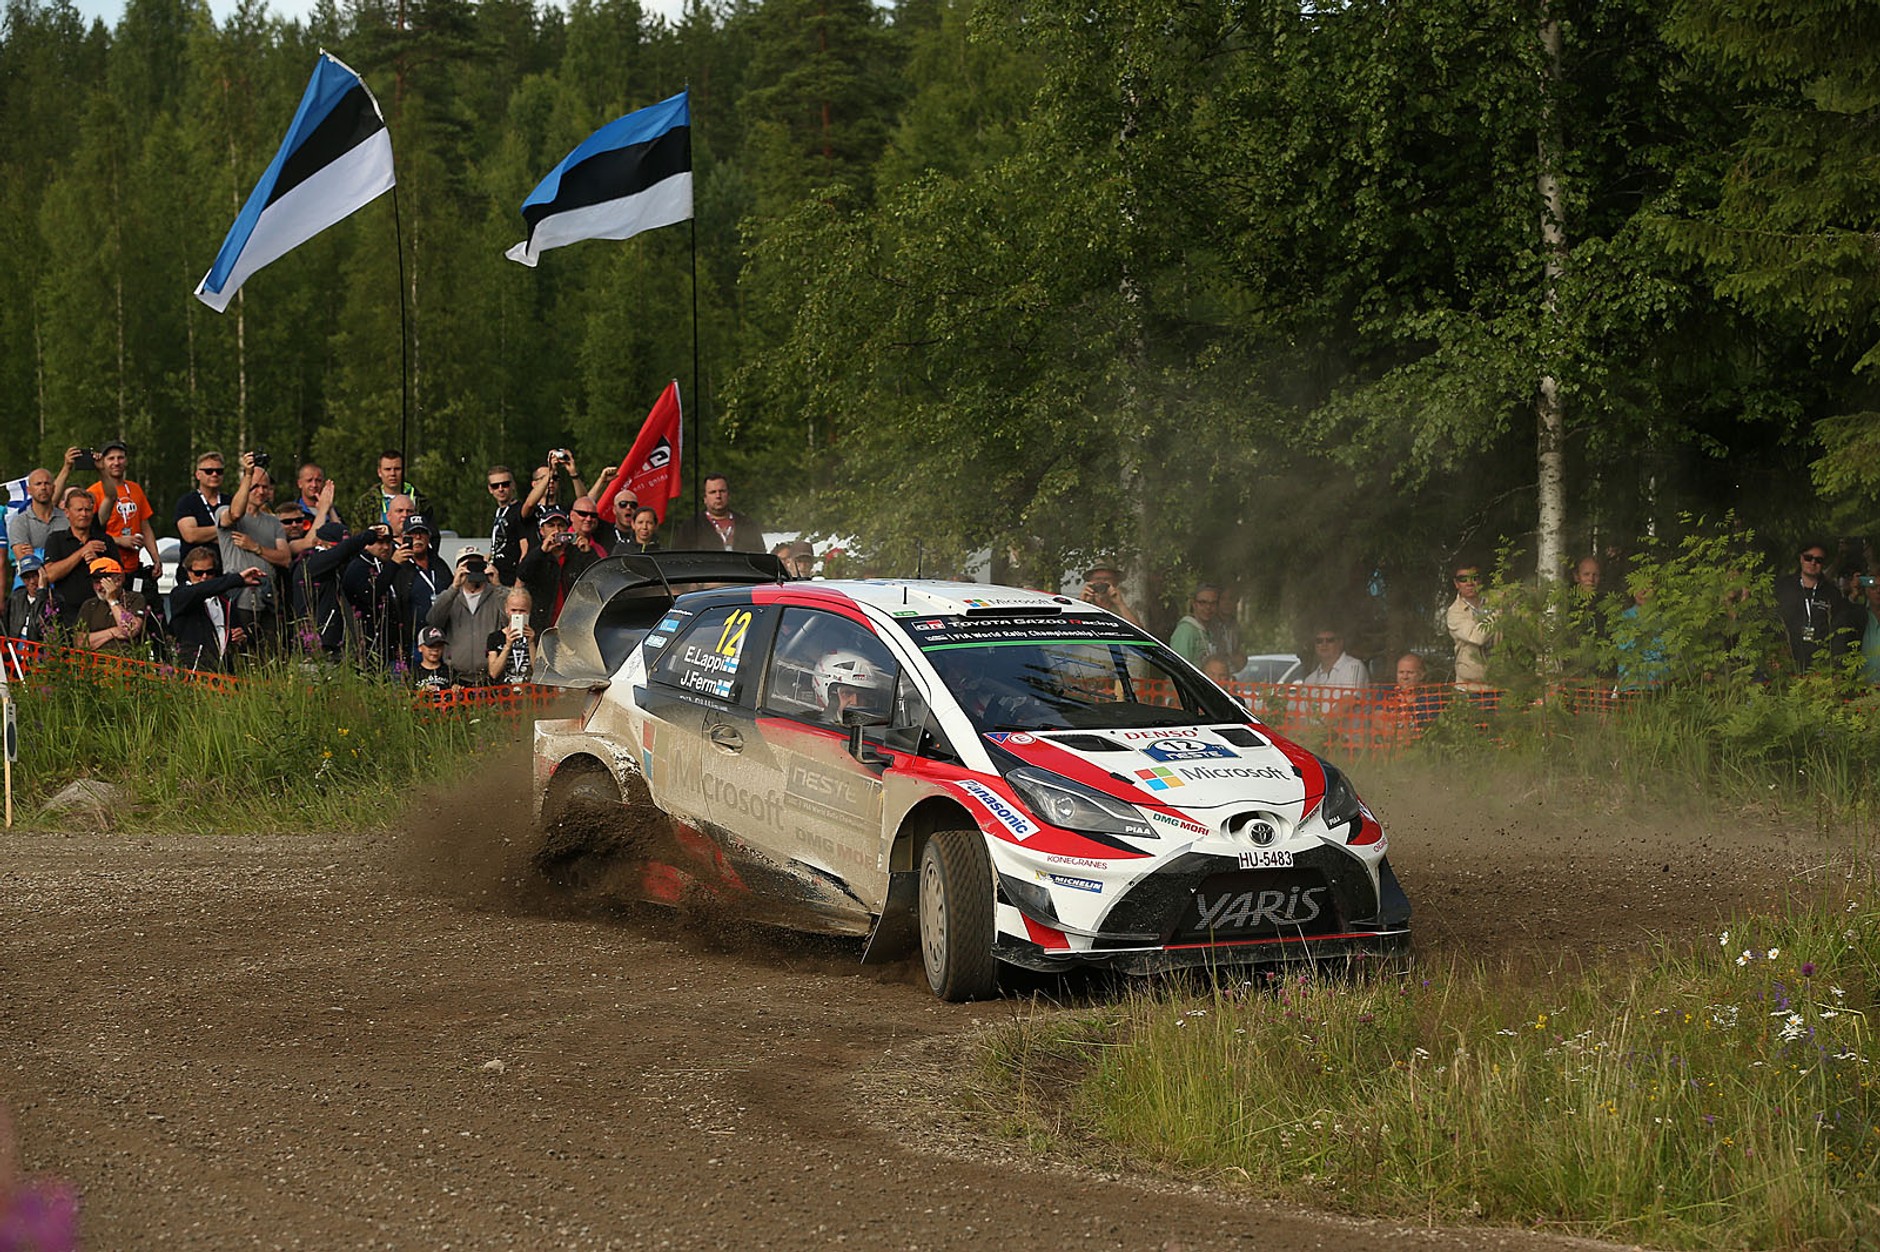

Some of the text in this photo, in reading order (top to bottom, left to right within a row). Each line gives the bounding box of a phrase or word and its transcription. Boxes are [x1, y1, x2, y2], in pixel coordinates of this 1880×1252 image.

[948, 618, 1119, 628] TOYOTA GAZOO Racing
[715, 608, 752, 657] 12
[955, 632, 973, 640] FIA
[972, 631, 1001, 639] World
[1002, 630, 1028, 638] Rally
[1028, 630, 1093, 638] Championship
[684, 646, 726, 673] E.Lappi
[680, 669, 717, 694] J.Ferm
[1124, 729, 1197, 740] DENSO
[1163, 740, 1196, 751] 12
[1165, 750, 1224, 760] NESTE
[1179, 766, 1291, 781] Microsoft
[673, 748, 784, 831] Microsoft
[959, 780, 1029, 835] Panasonic
[1125, 825, 1151, 835] PIAA
[1153, 813, 1210, 836] DMG MORI
[1047, 856, 1108, 870] KONECRANES
[1239, 850, 1293, 867] HU-5483
[1055, 876, 1102, 890] MICHELIN
